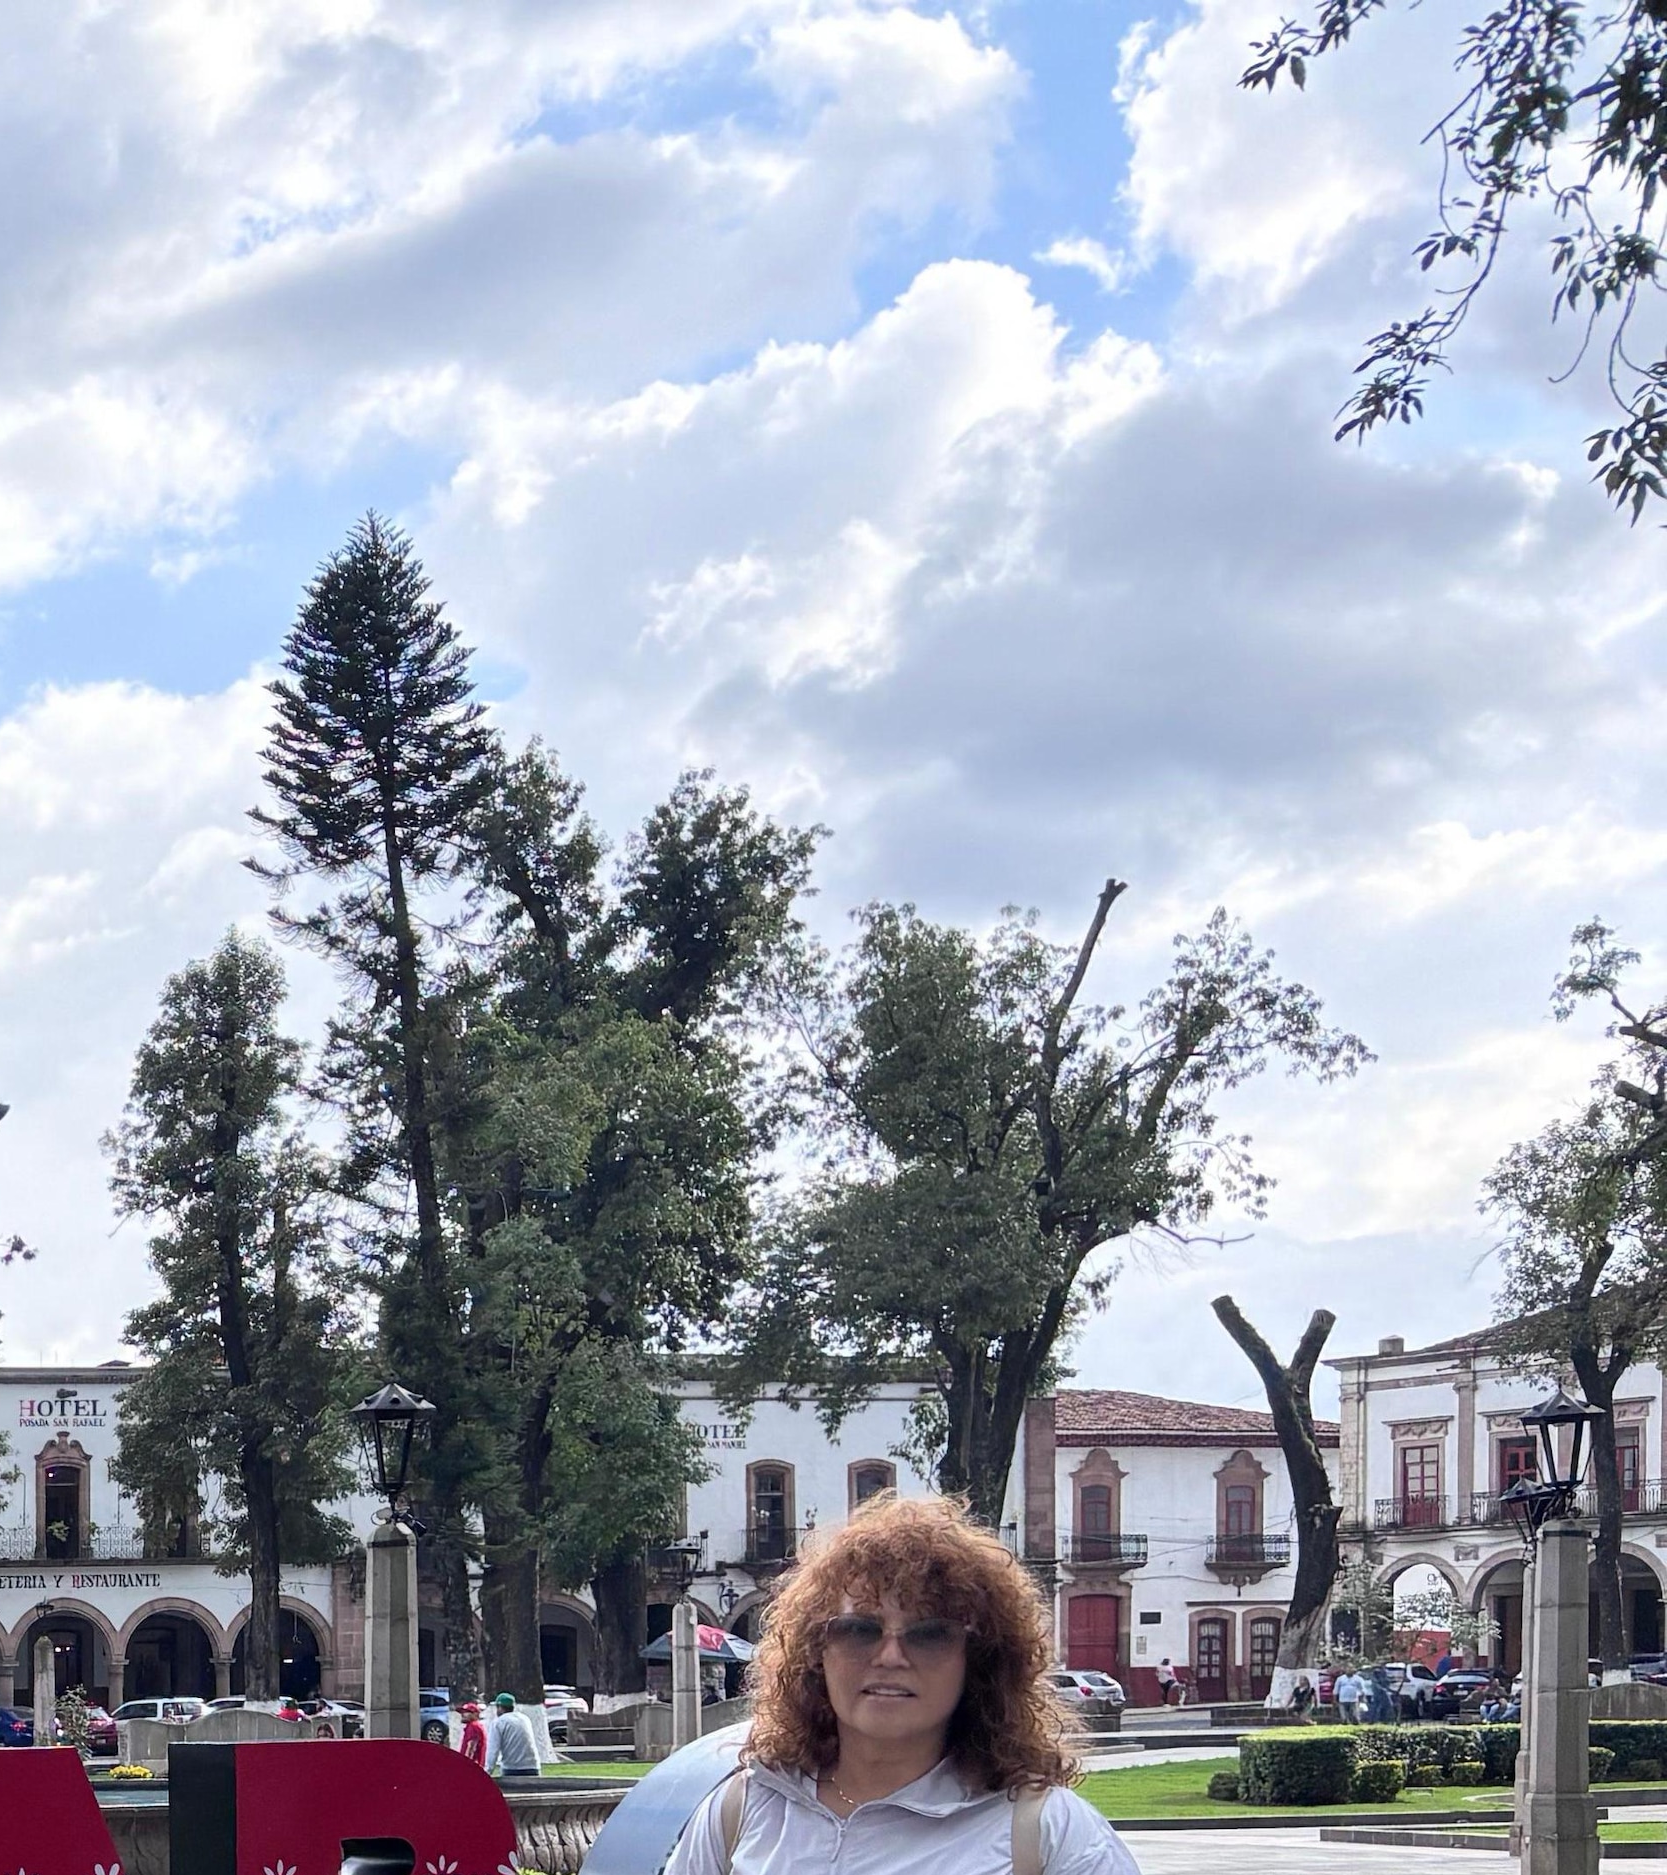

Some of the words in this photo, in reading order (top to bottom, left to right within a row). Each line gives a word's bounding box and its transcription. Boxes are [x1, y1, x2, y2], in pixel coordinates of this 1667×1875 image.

[19, 1399, 107, 1417] HOTEL
[19, 1418, 49, 1428] POSADA
[53, 1418, 69, 1427] SAN
[72, 1418, 107, 1428] RAFAEL
[54, 1575, 64, 1589] Y
[72, 1573, 161, 1589] RESTAURANTE
